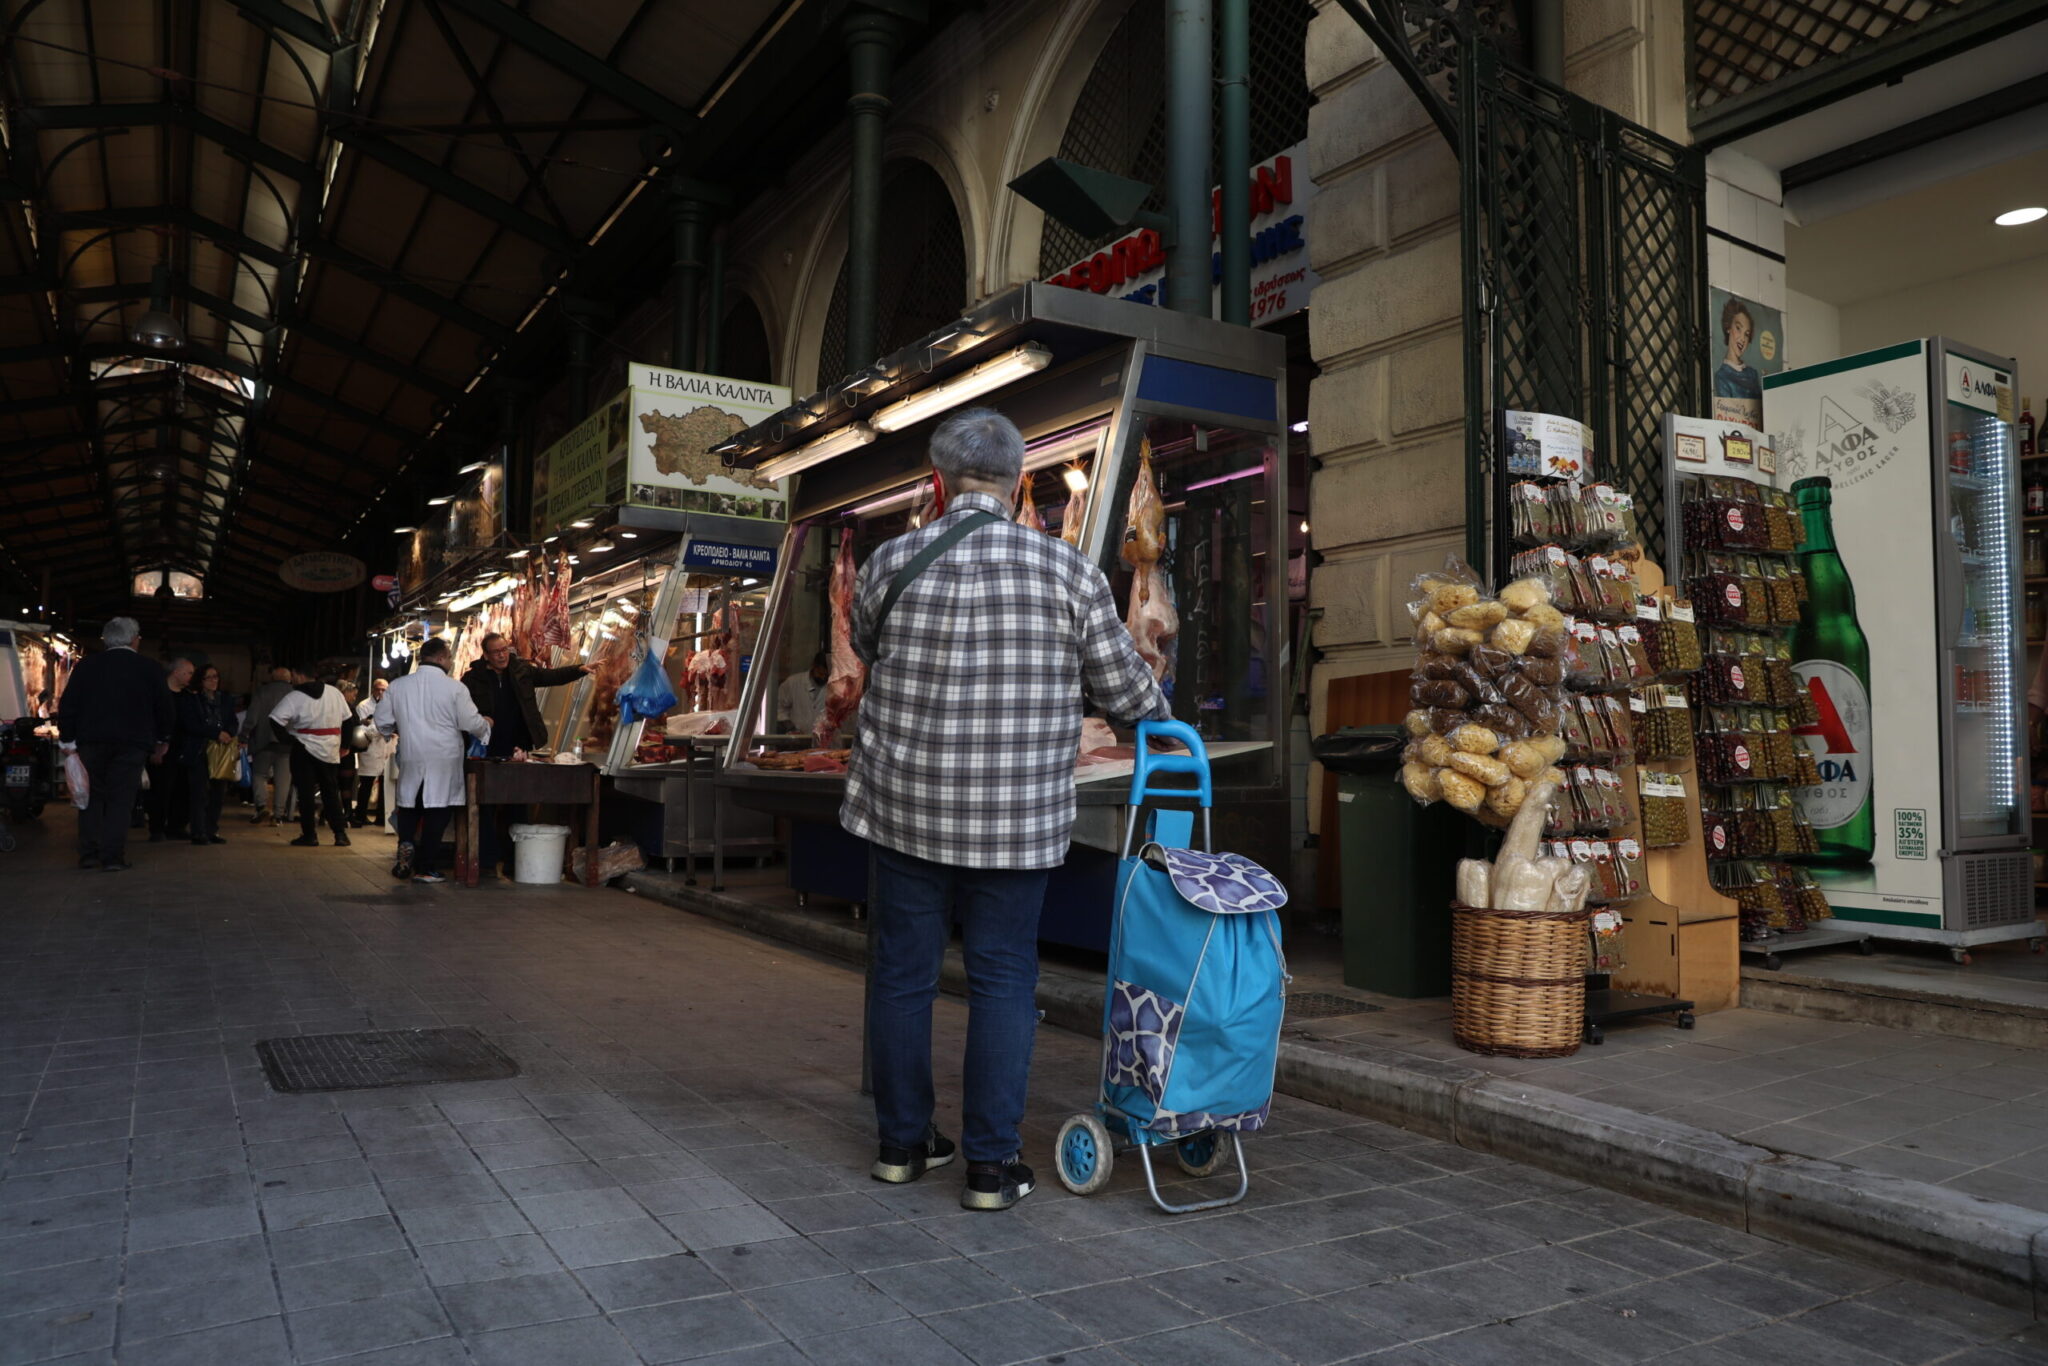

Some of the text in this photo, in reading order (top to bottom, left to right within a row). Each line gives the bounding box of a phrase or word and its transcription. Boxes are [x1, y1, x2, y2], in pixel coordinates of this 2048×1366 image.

[1254, 267, 1306, 297] ιδρύσεως
[1248, 290, 1287, 320] 1976
[649, 372, 774, 405] Η ΒΑΛΙΑ ΚΑΛΝΤΑ
[1974, 380, 1997, 398] ΑΛΦΑ
[1815, 426, 1879, 470] ΑΛΦΑ
[1824, 445, 1877, 478] ΖΥΘΟΣ
[693, 544, 729, 558] ΚΡΕΟΠΩΛΕΙΟ
[732, 547, 748, 560] ΒΑΛΙΑ
[749, 549, 771, 562] ΚΑΛΝΤΑ
[711, 558, 744, 568] ΑΡΜΟΔΙΟΥ
[1816, 759, 1857, 782] ΦΑ
[1897, 811, 1922, 821] 100%
[1899, 827, 1923, 839] 35%
